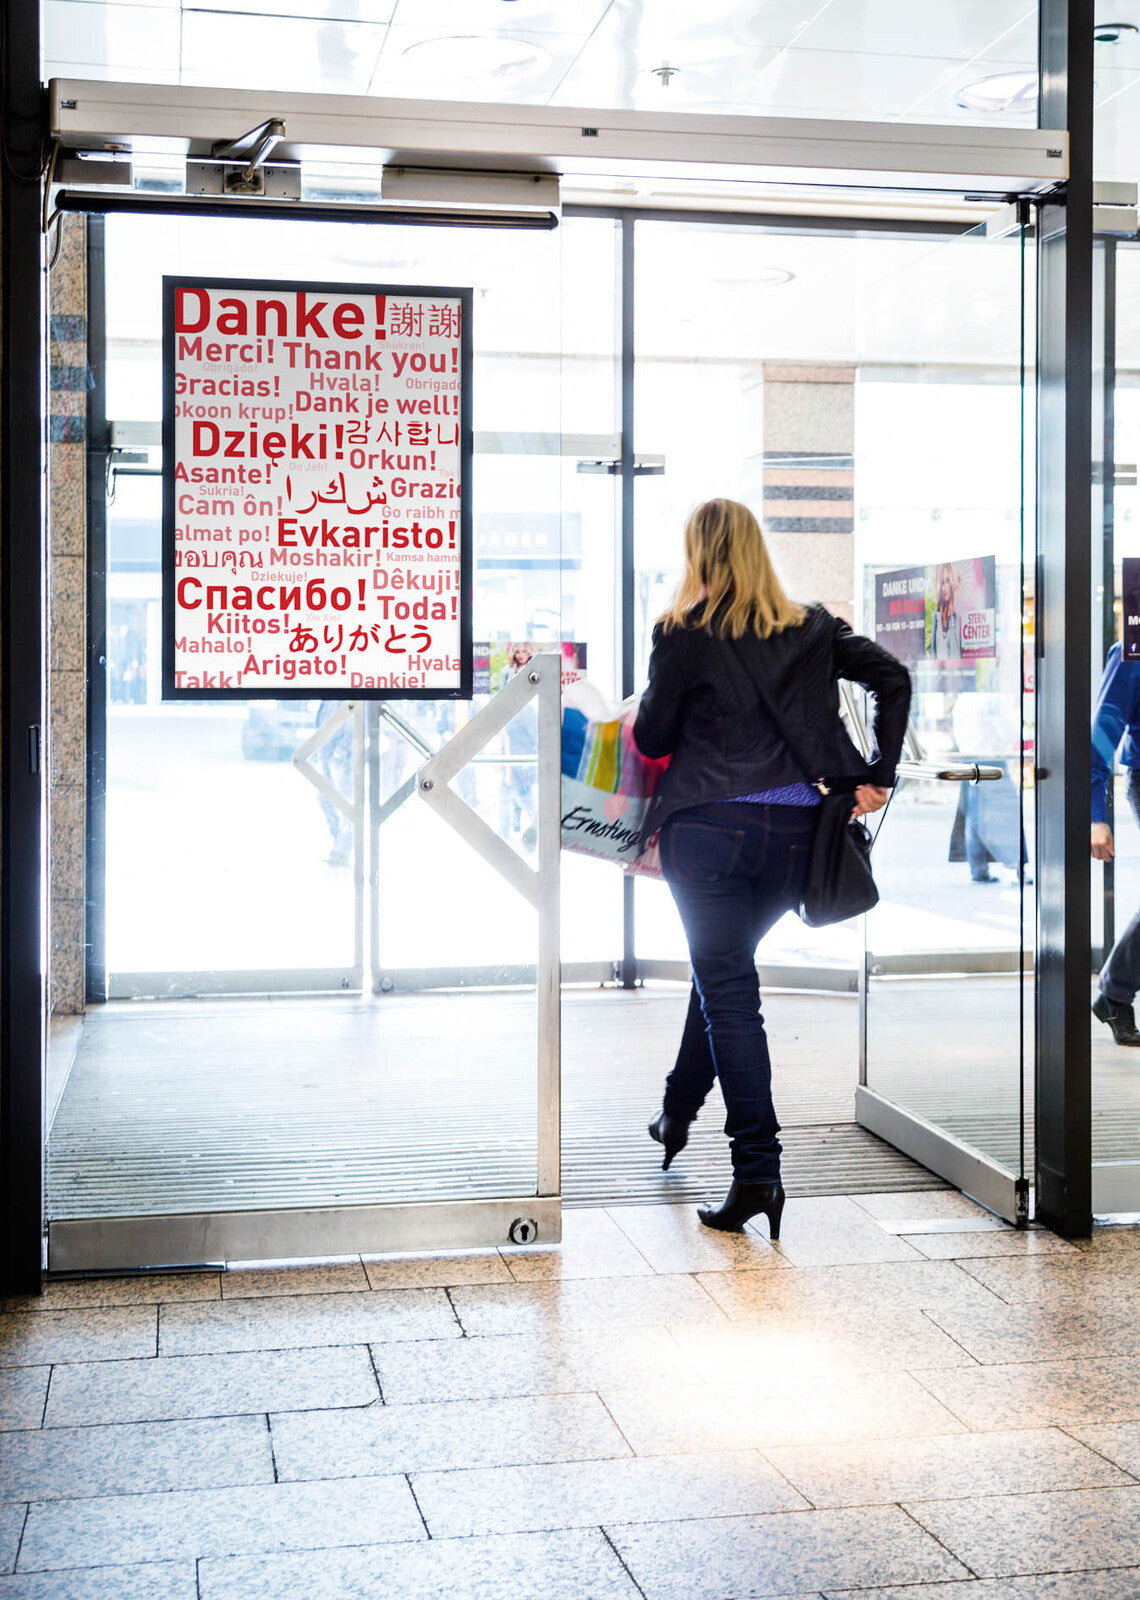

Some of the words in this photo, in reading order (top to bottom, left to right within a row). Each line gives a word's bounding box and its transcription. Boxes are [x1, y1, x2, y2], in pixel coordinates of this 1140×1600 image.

[175, 287, 387, 341] Danke!
[389, 302, 460, 339] 謝謝
[178, 336, 274, 364] Merci!
[379, 340, 425, 350] Shukran!
[202, 362, 258, 375] Obrigado!
[283, 342, 382, 372] Thank
[392, 347, 458, 378] you!
[175, 373, 280, 397] Gracias!
[310, 372, 380, 392] Hvala!
[239, 403, 294, 423] krup!
[295, 390, 359, 414] Dank
[365, 393, 389, 418] je
[396, 395, 459, 416] well!
[192, 420, 345, 467] Dzięki!
[345, 420, 459, 447] 감사합니
[350, 448, 436, 471] Orkun!
[175, 462, 271, 484] Asante!
[199, 485, 246, 497] Sukria!
[179, 496, 234, 516] Cam
[244, 494, 283, 516] ôn!
[382, 505, 401, 519] Go
[406, 506, 445, 519] raibh
[239, 526, 270, 545] po!
[278, 518, 456, 549] Evkaristo!
[270, 548, 381, 567] Moshakir!
[386, 552, 424, 562] Kamsa
[251, 571, 308, 583] Dziekuje!
[373, 569, 460, 595] Dêkuji!
[177, 576, 366, 611] Спасибо!
[377, 595, 458, 620] Toda!
[968, 612, 986, 624] STERN
[207, 613, 290, 634] Kiitos!
[962, 623, 990, 640] CENTER
[175, 636, 252, 653] Mahalo!
[289, 622, 432, 654] ありがとう
[243, 654, 347, 680] Arigato!
[175, 671, 242, 688] Takk!
[351, 672, 426, 688] Dankie!
